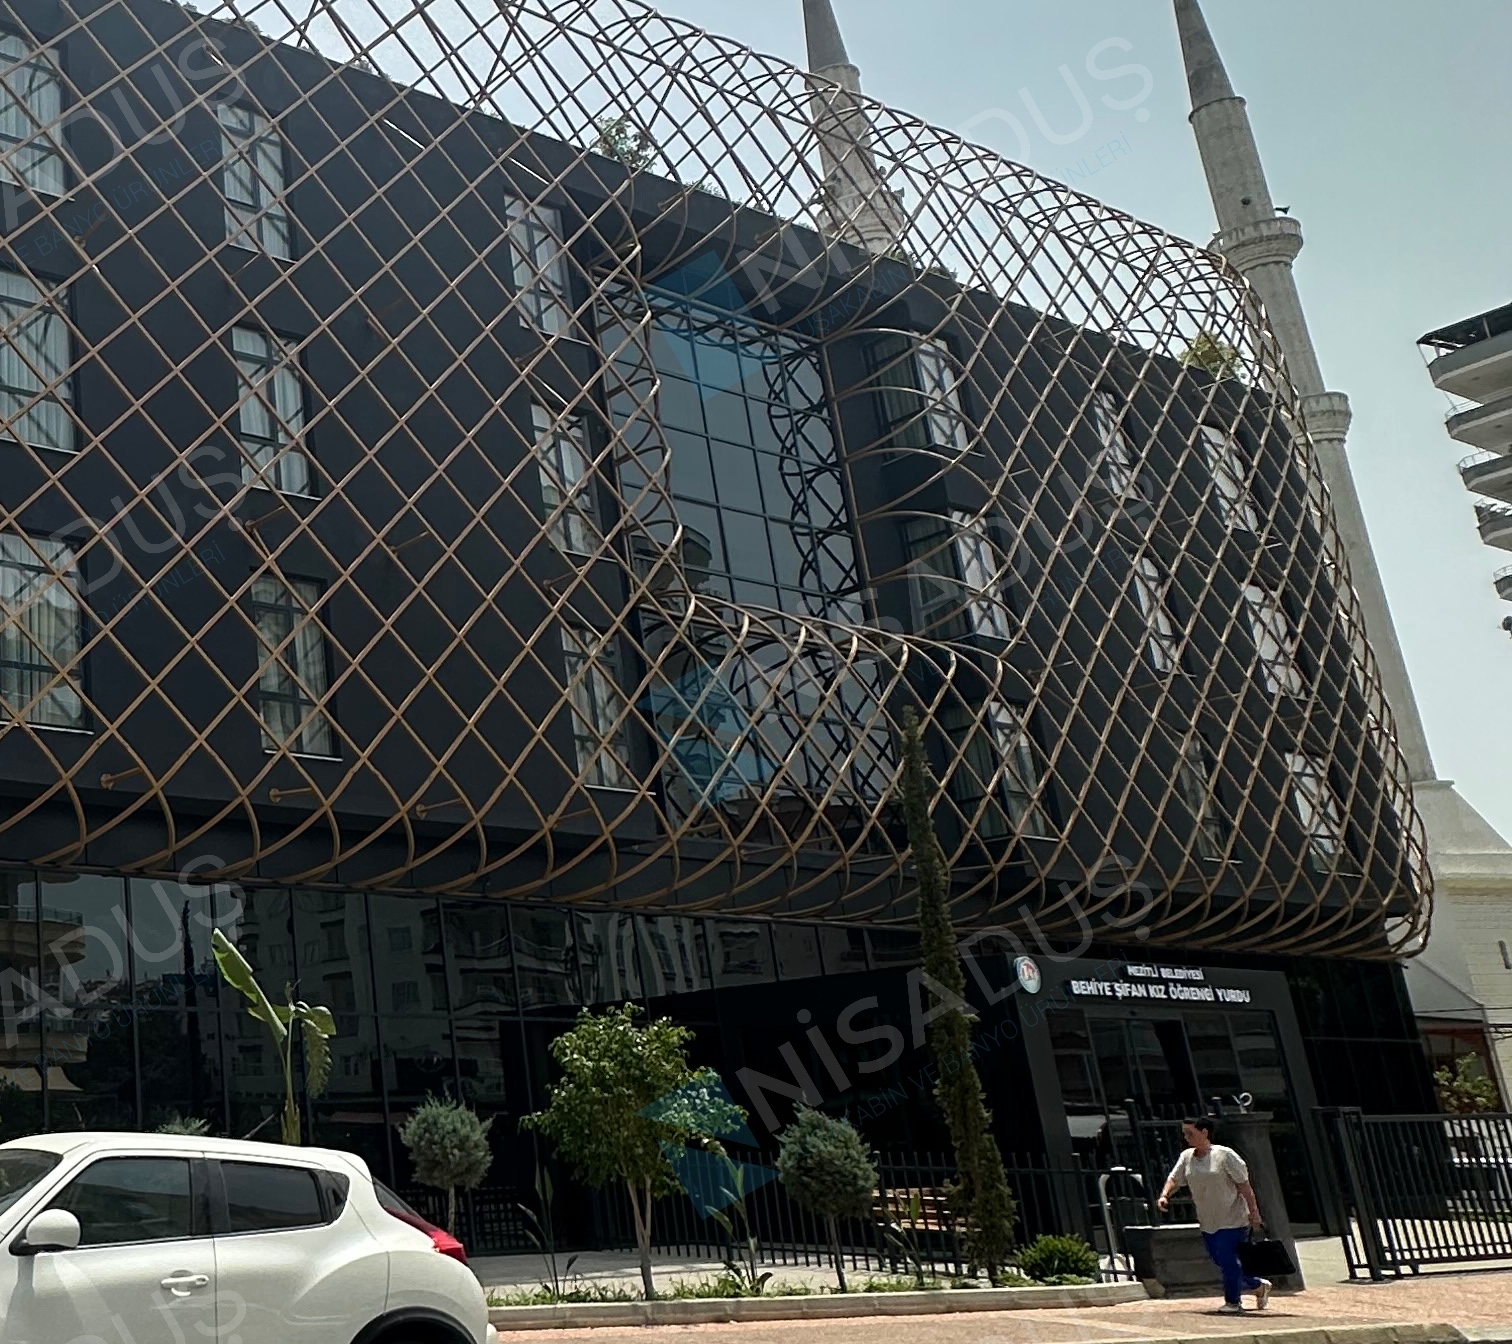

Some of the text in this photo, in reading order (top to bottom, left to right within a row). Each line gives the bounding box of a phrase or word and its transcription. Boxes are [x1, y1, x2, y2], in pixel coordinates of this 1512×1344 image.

[1071, 977, 1251, 1004] BEHİYE ŞİFAN KIZ ÖĞRENCİ YURDU
